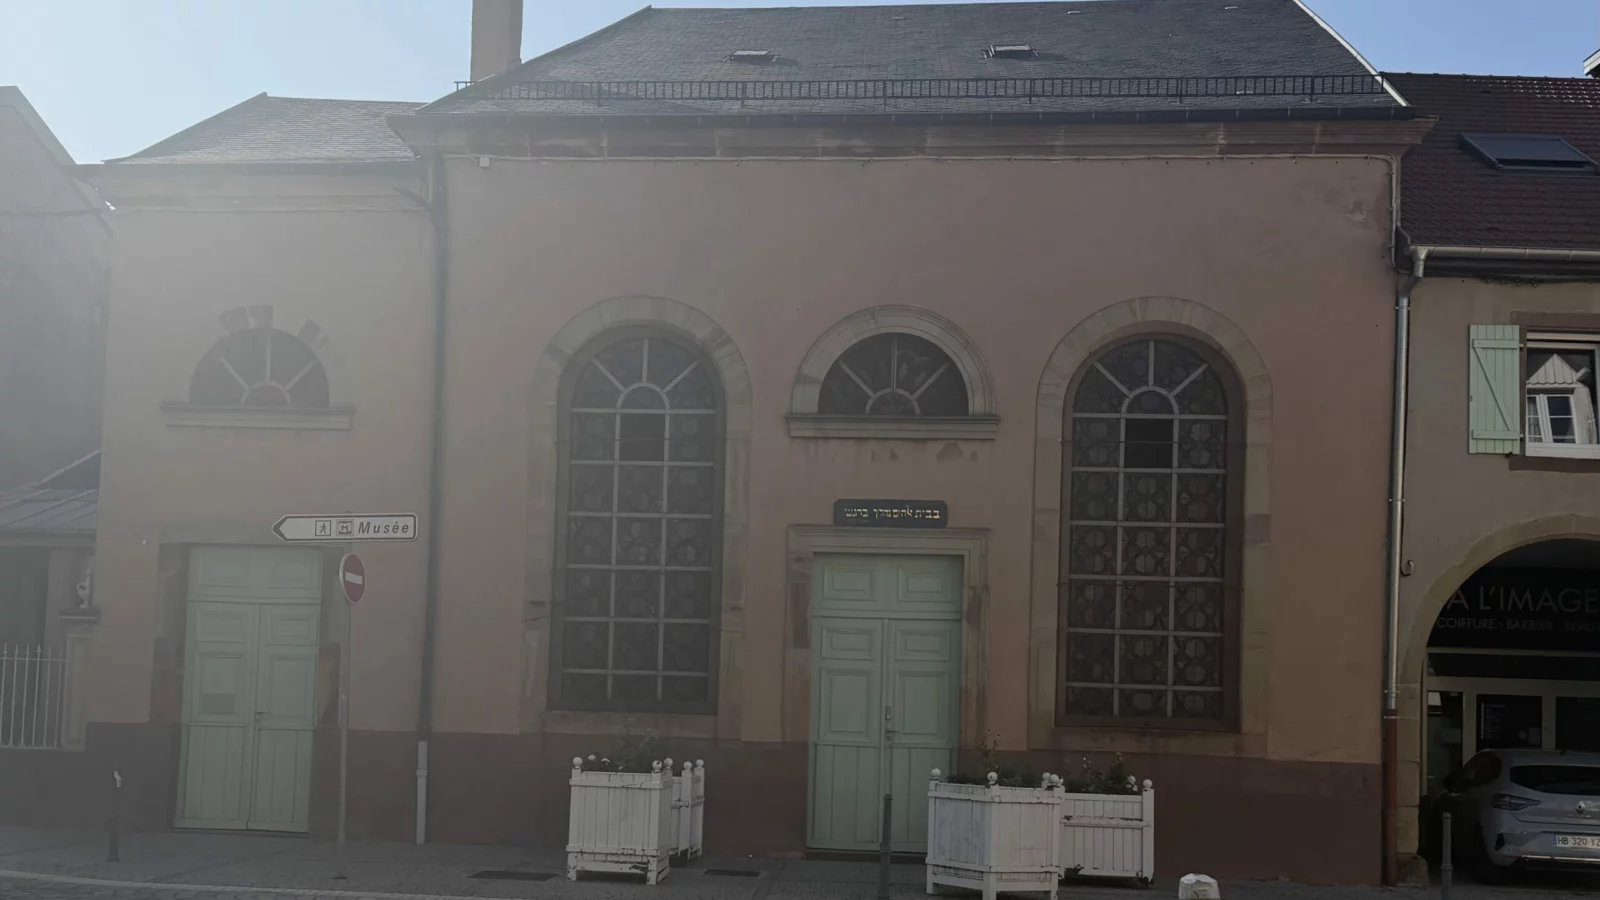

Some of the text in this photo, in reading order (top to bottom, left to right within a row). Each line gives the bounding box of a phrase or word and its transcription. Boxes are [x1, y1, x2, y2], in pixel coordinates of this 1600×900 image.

[915, 508, 940, 519] בבית
[358, 521, 409, 534] Musée
[1479, 585, 1599, 613] L'IMAGE
[1436, 617, 1496, 630] COIFFURE
[1506, 619, 1553, 631] BARBIER
